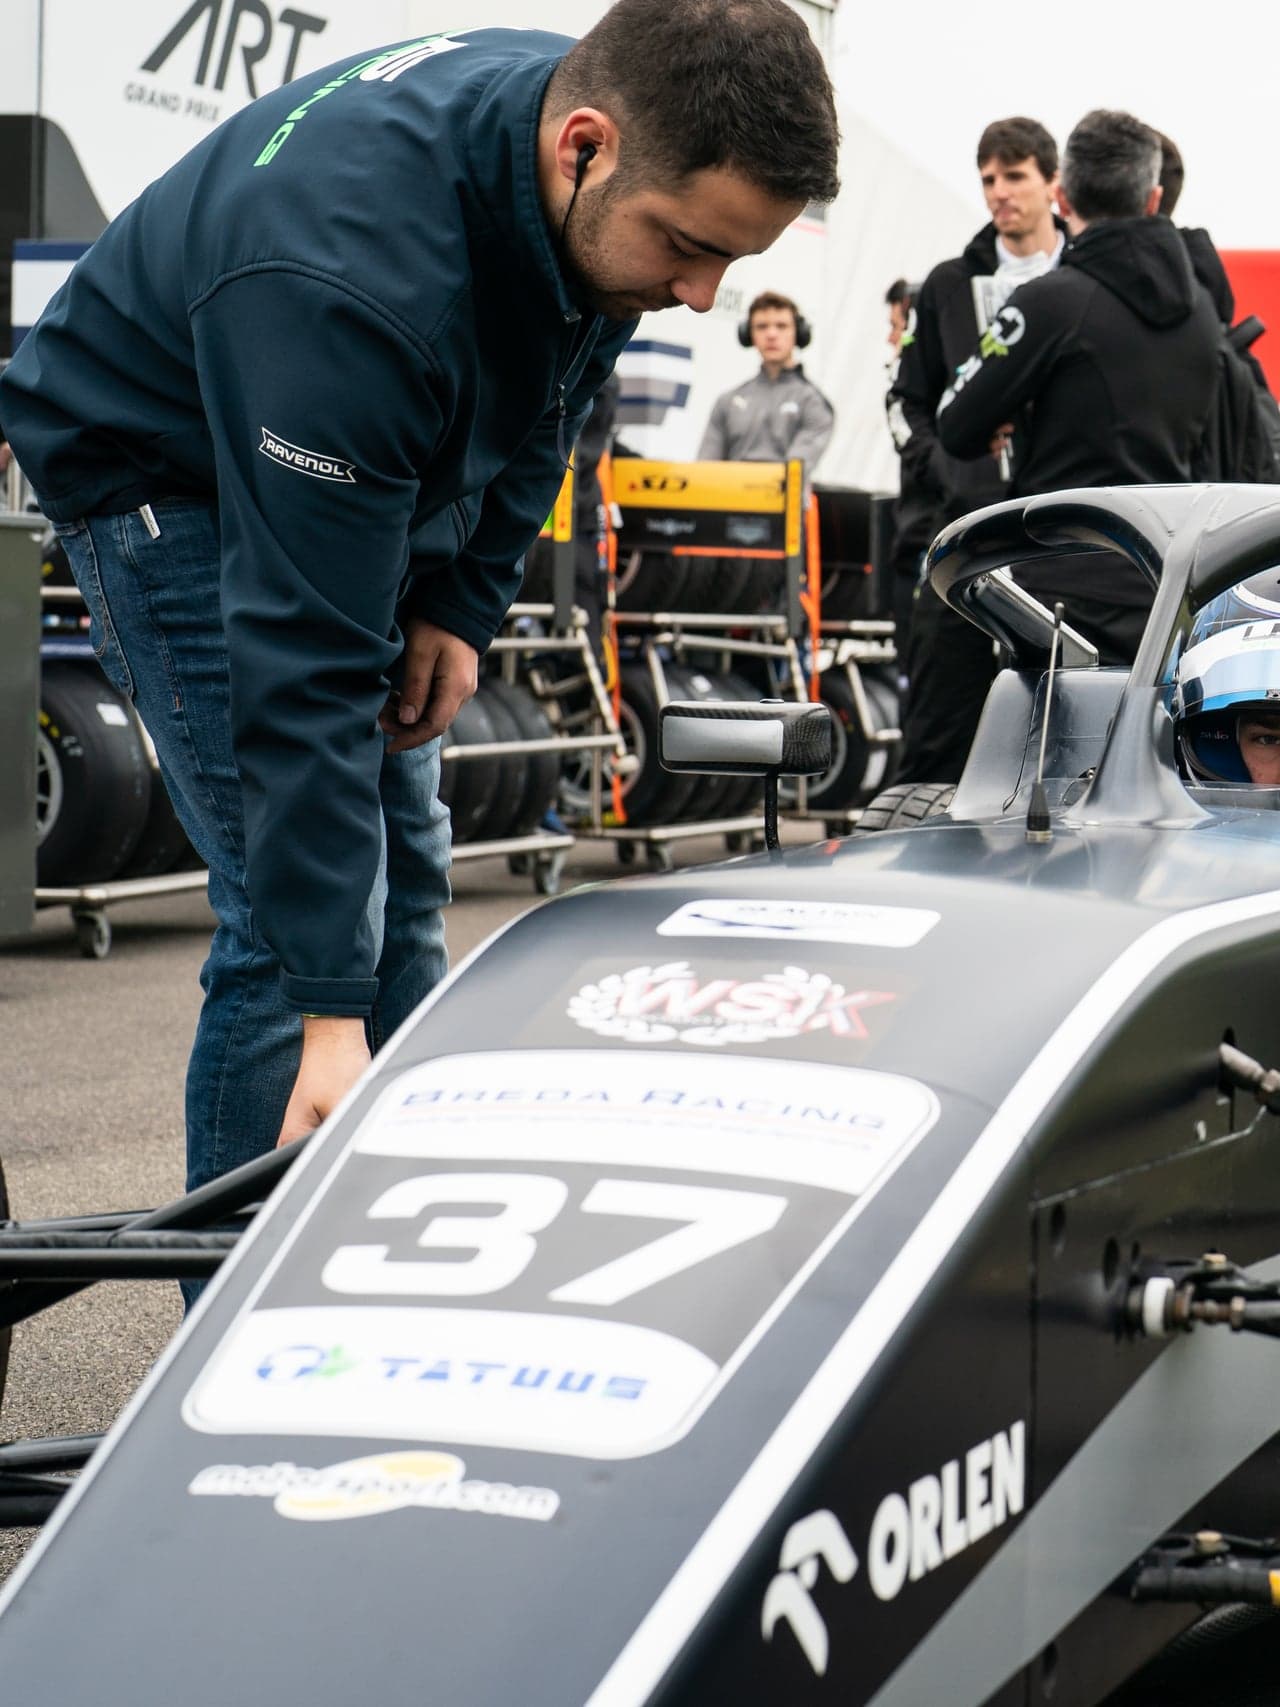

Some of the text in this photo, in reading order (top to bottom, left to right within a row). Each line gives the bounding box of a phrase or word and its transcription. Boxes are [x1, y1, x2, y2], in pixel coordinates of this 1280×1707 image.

[140, 0, 328, 100] ART
[123, 82, 181, 114] GRAND
[266, 438, 345, 476] RAVENOL
[617, 975, 896, 1040] WSK
[400, 1088, 887, 1130] BREDA RACING
[321, 1173, 788, 1307] 37
[380, 1357, 648, 1400] TATUUS
[192, 1464, 558, 1519] motorsport.com
[868, 1419, 1025, 1601] ORLEN
